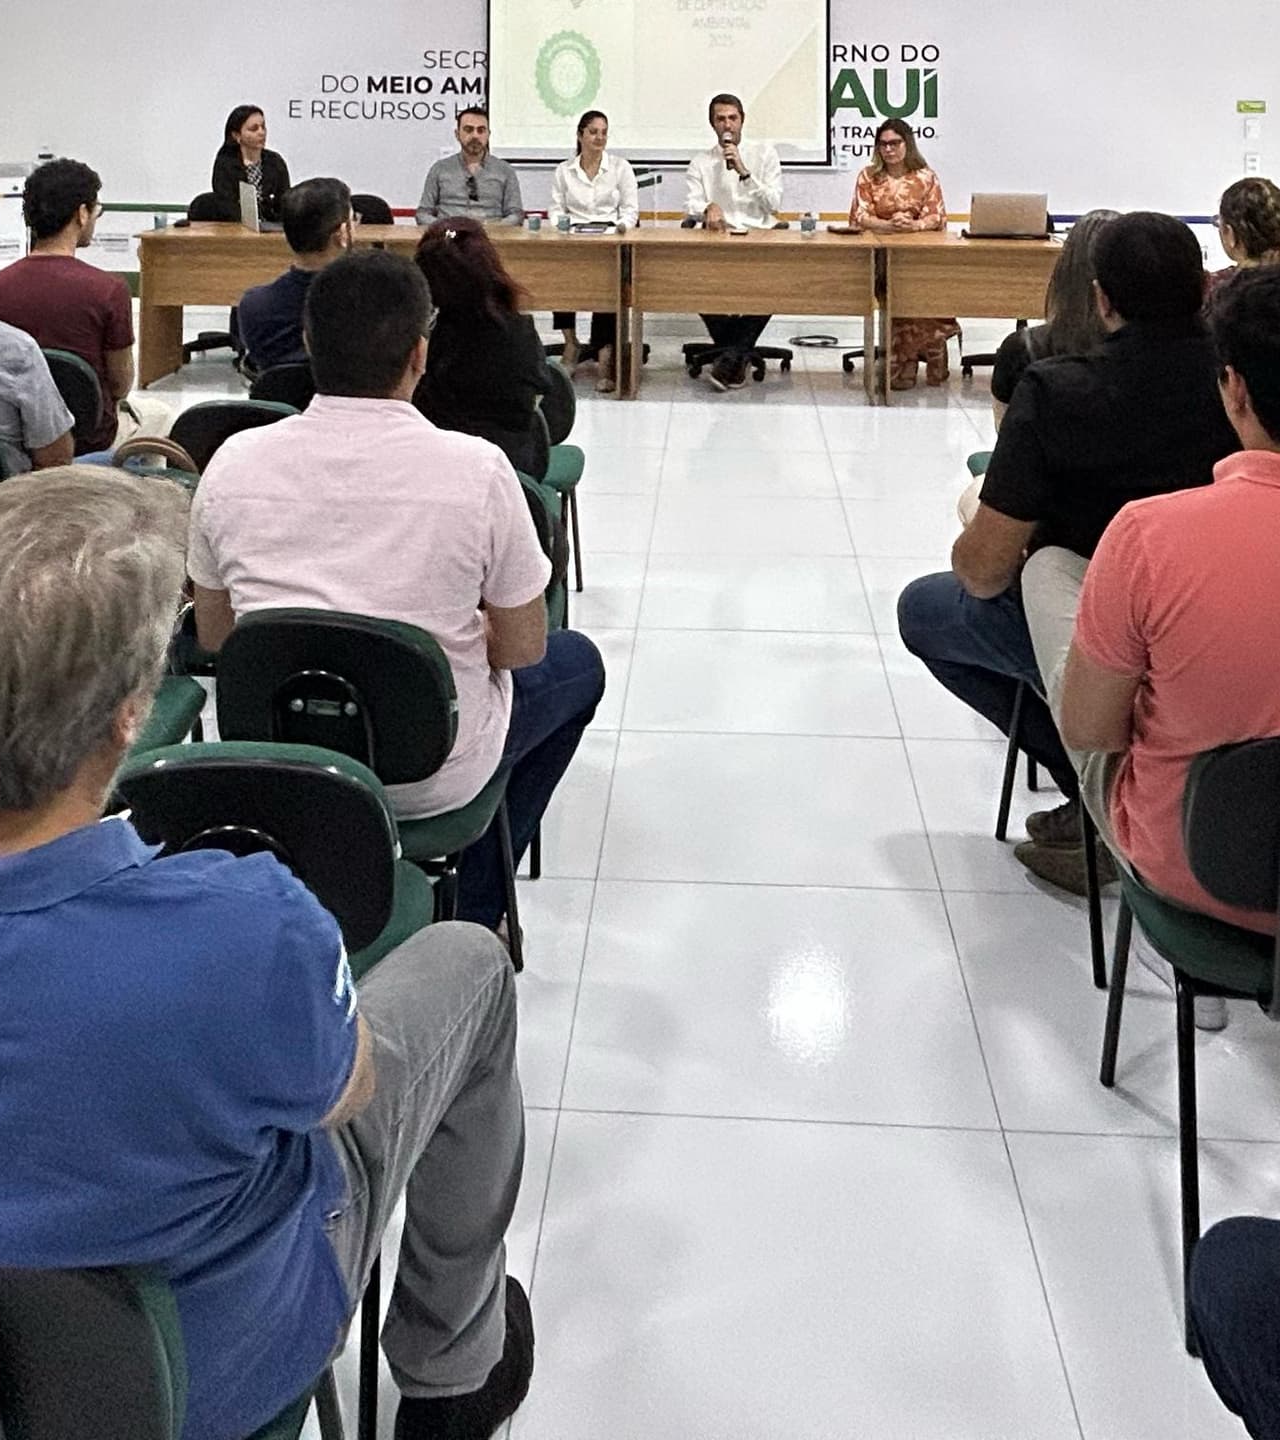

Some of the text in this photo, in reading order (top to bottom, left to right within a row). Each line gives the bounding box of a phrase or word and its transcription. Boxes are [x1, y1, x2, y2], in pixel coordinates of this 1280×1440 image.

[423, 50, 488, 70] SECR
[832, 45, 940, 62] RNO DO
[321, 74, 486, 96] DO MEIO AM
[830, 68, 938, 118] AUÍ
[288, 99, 303, 119] E
[311, 100, 446, 121] RECURSOS
